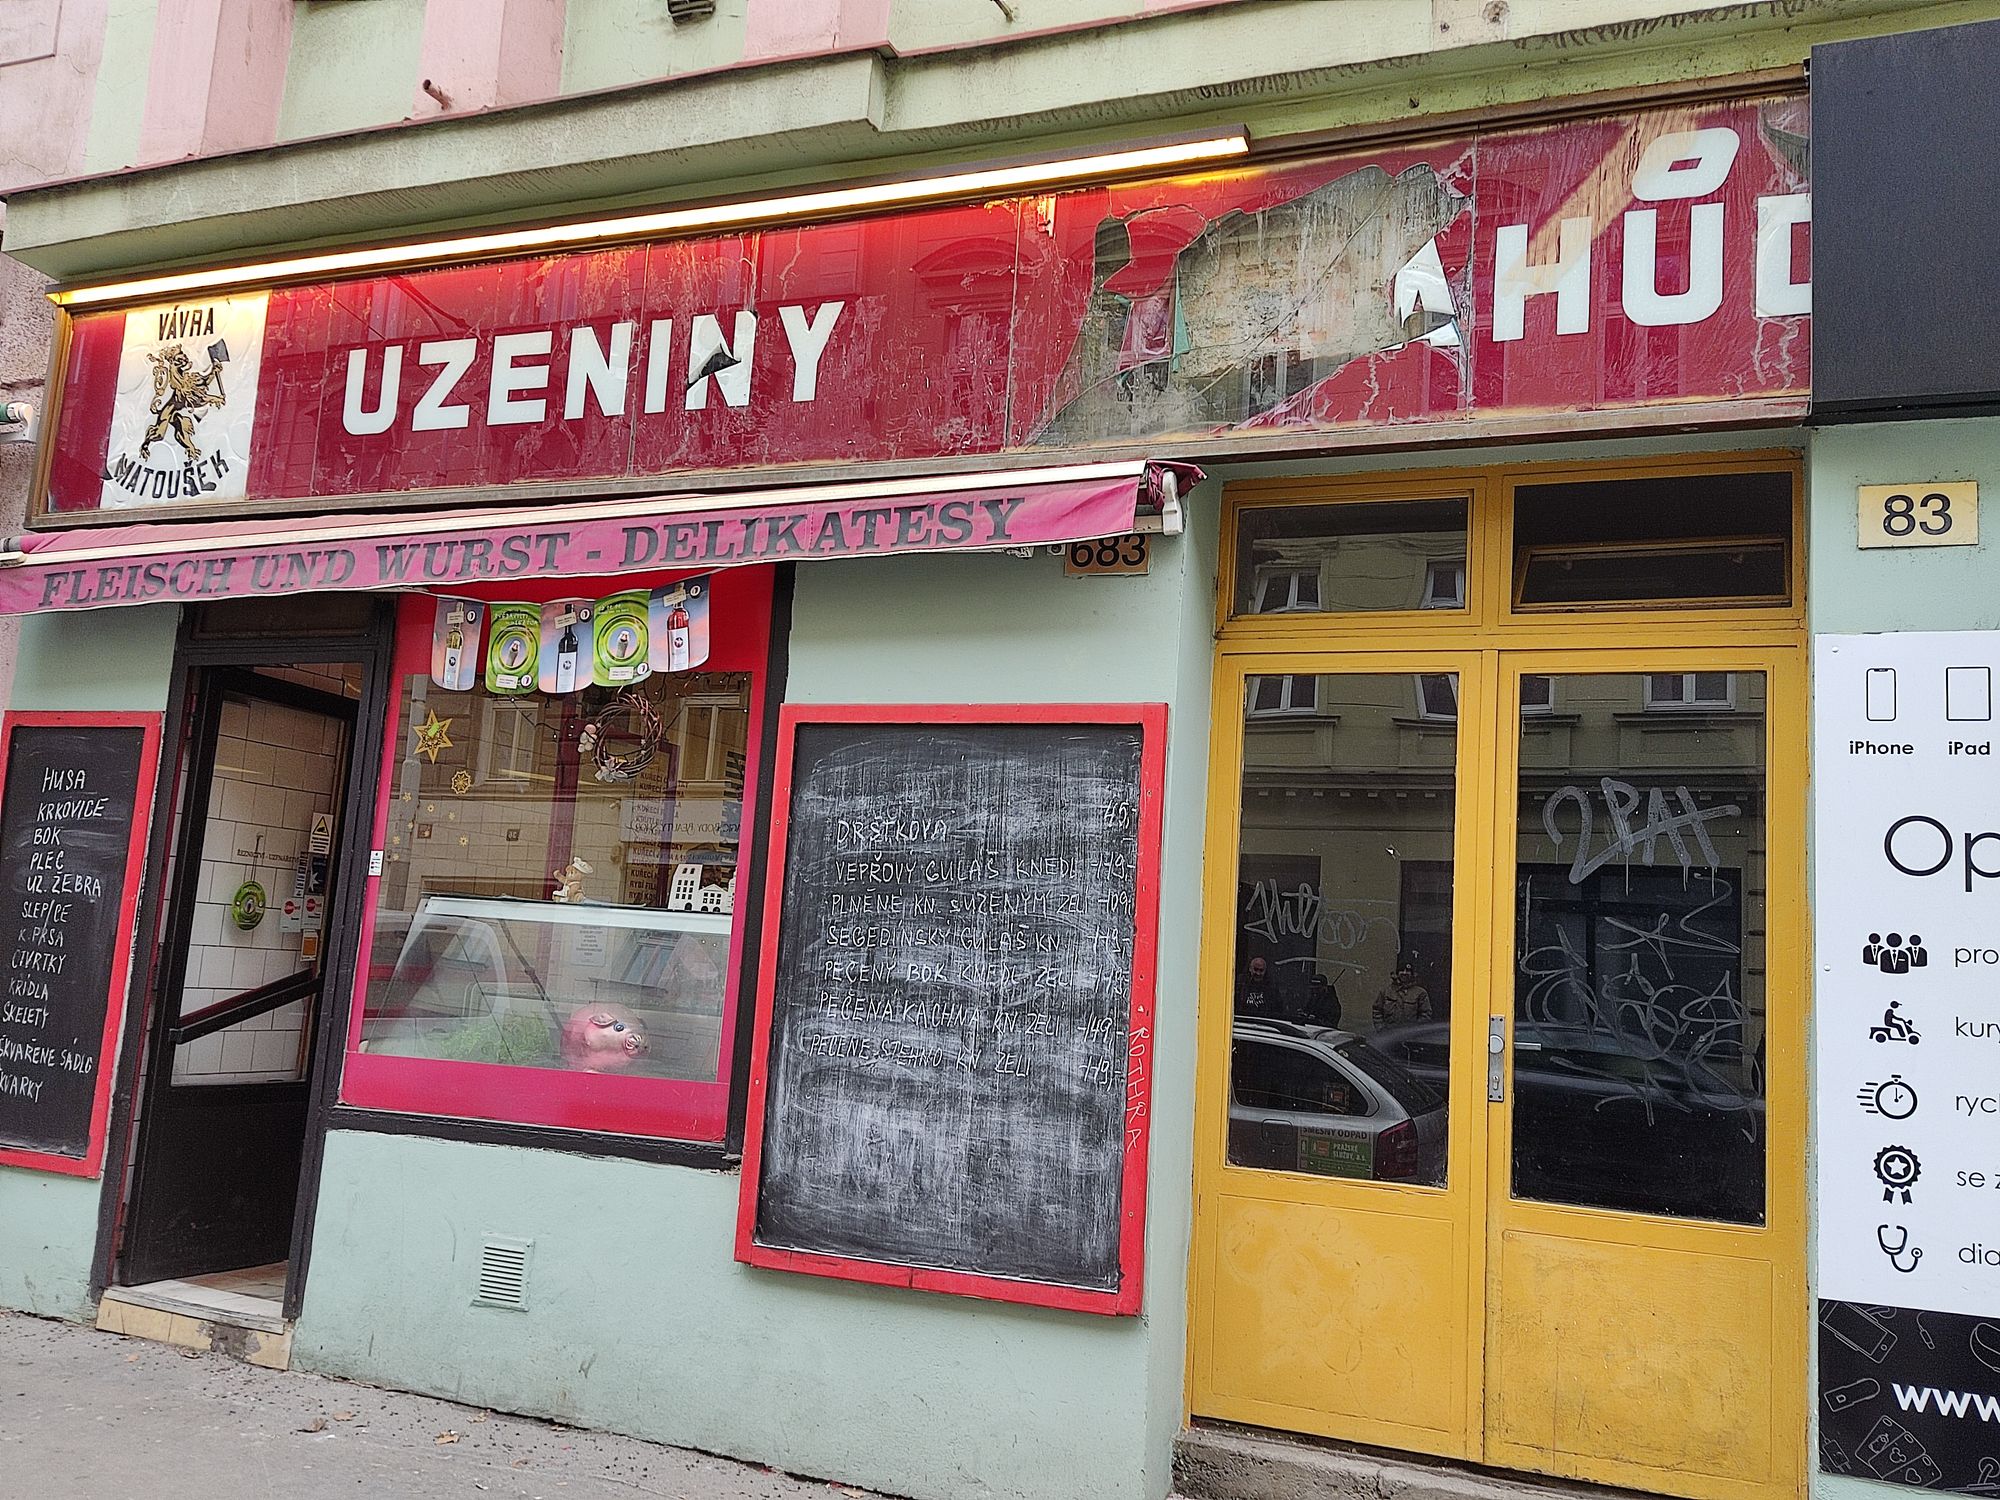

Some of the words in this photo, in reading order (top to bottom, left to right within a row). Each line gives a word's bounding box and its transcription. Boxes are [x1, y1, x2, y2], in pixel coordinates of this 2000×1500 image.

[158, 305, 214, 341] VÁVRA
[342, 300, 845, 436] UZENINY
[113, 449, 229, 499] MATOUŠEK
[1882, 493, 1953, 536] 83
[38, 556, 232, 608] FLEISCH
[250, 549, 356, 591] UND
[376, 532, 571, 581] WURST
[618, 497, 1025, 566] DELIKATESY
[1070, 532, 1146, 568] 683
[1848, 739, 1915, 756] iPhone
[1947, 739, 1991, 756] iPad
[42, 767, 86, 793] HUSA
[33, 826, 61, 846] BOK
[22, 899, 73, 924] SLEPICE
[906, 962, 948, 983] BOK
[1956, 1016, 2000, 1043] kur
[1956, 1092, 2000, 1117] ryc
[1956, 1170, 1985, 1188] se
